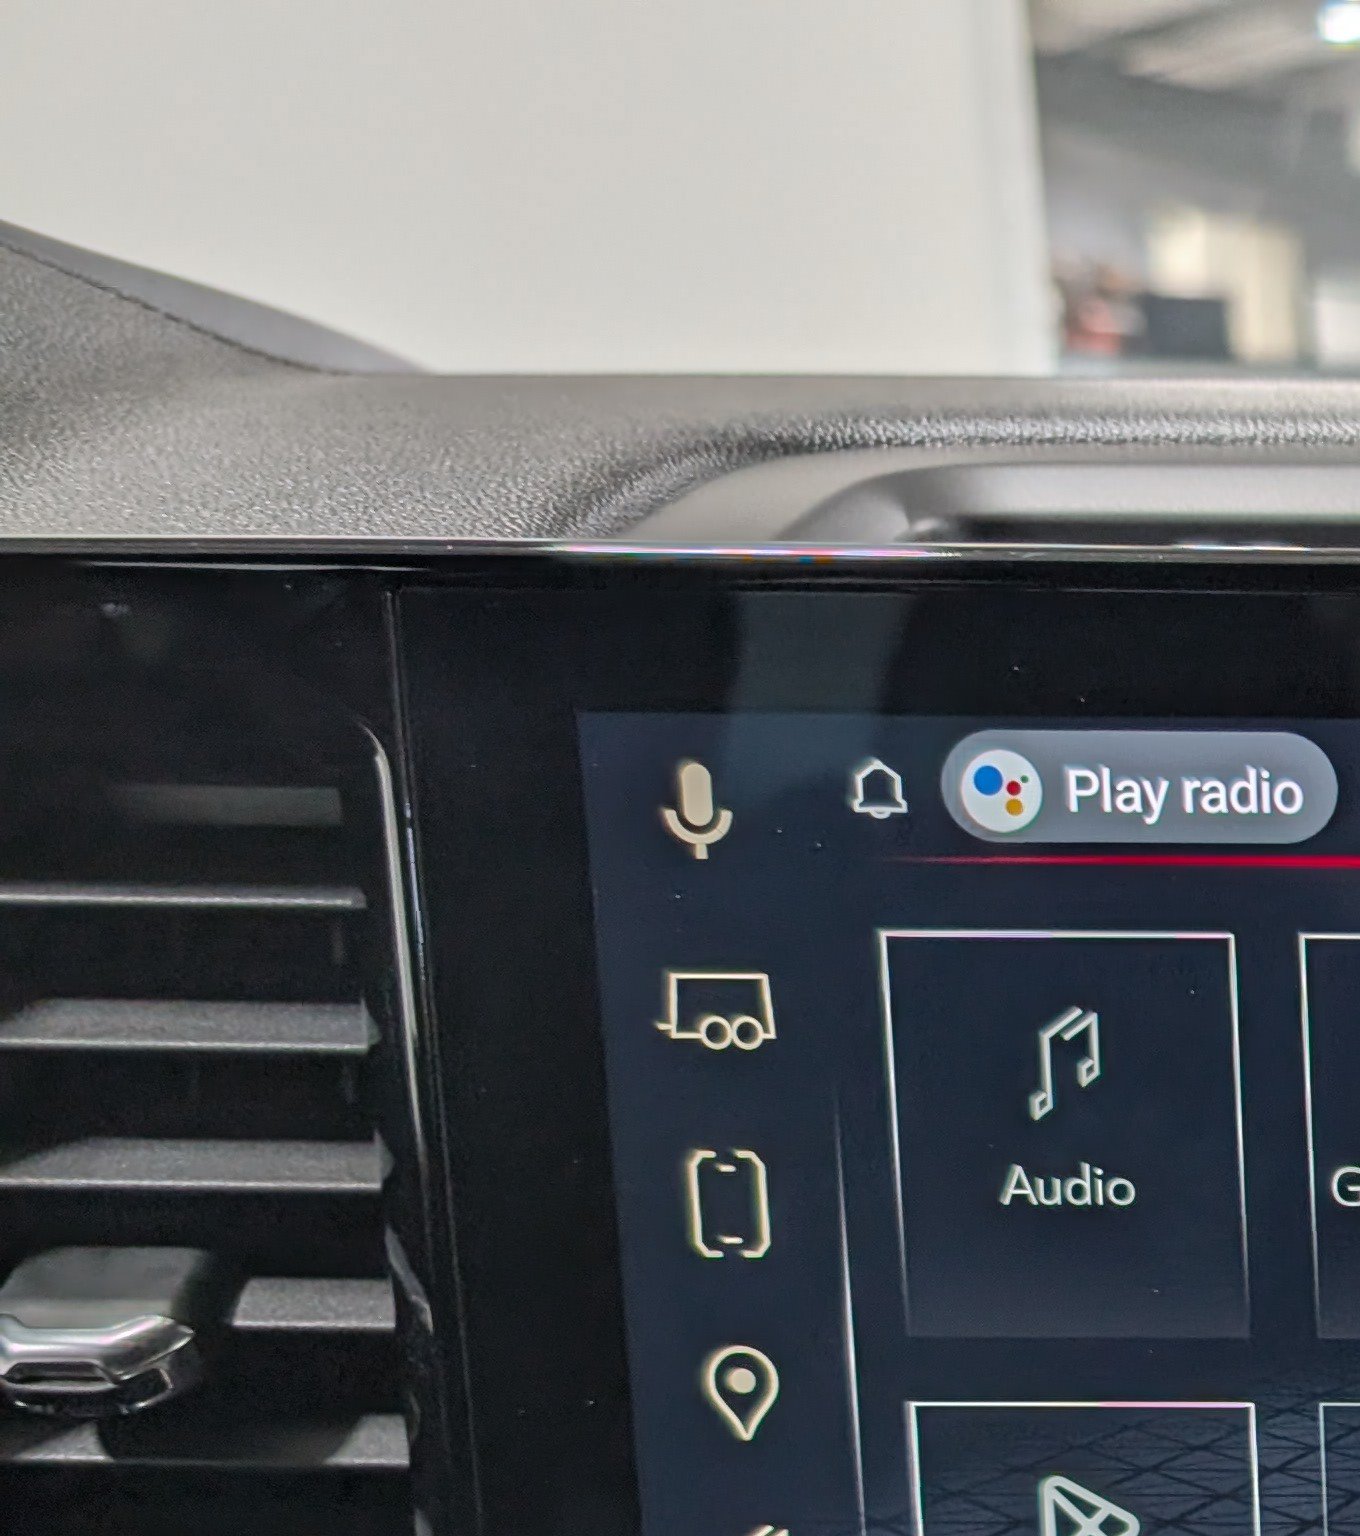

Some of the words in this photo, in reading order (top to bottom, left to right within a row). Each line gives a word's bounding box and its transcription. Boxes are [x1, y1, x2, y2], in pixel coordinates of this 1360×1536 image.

[1065, 765, 1170, 826] Play
[1182, 765, 1304, 816] radio
[999, 1161, 1137, 1207] Audio
